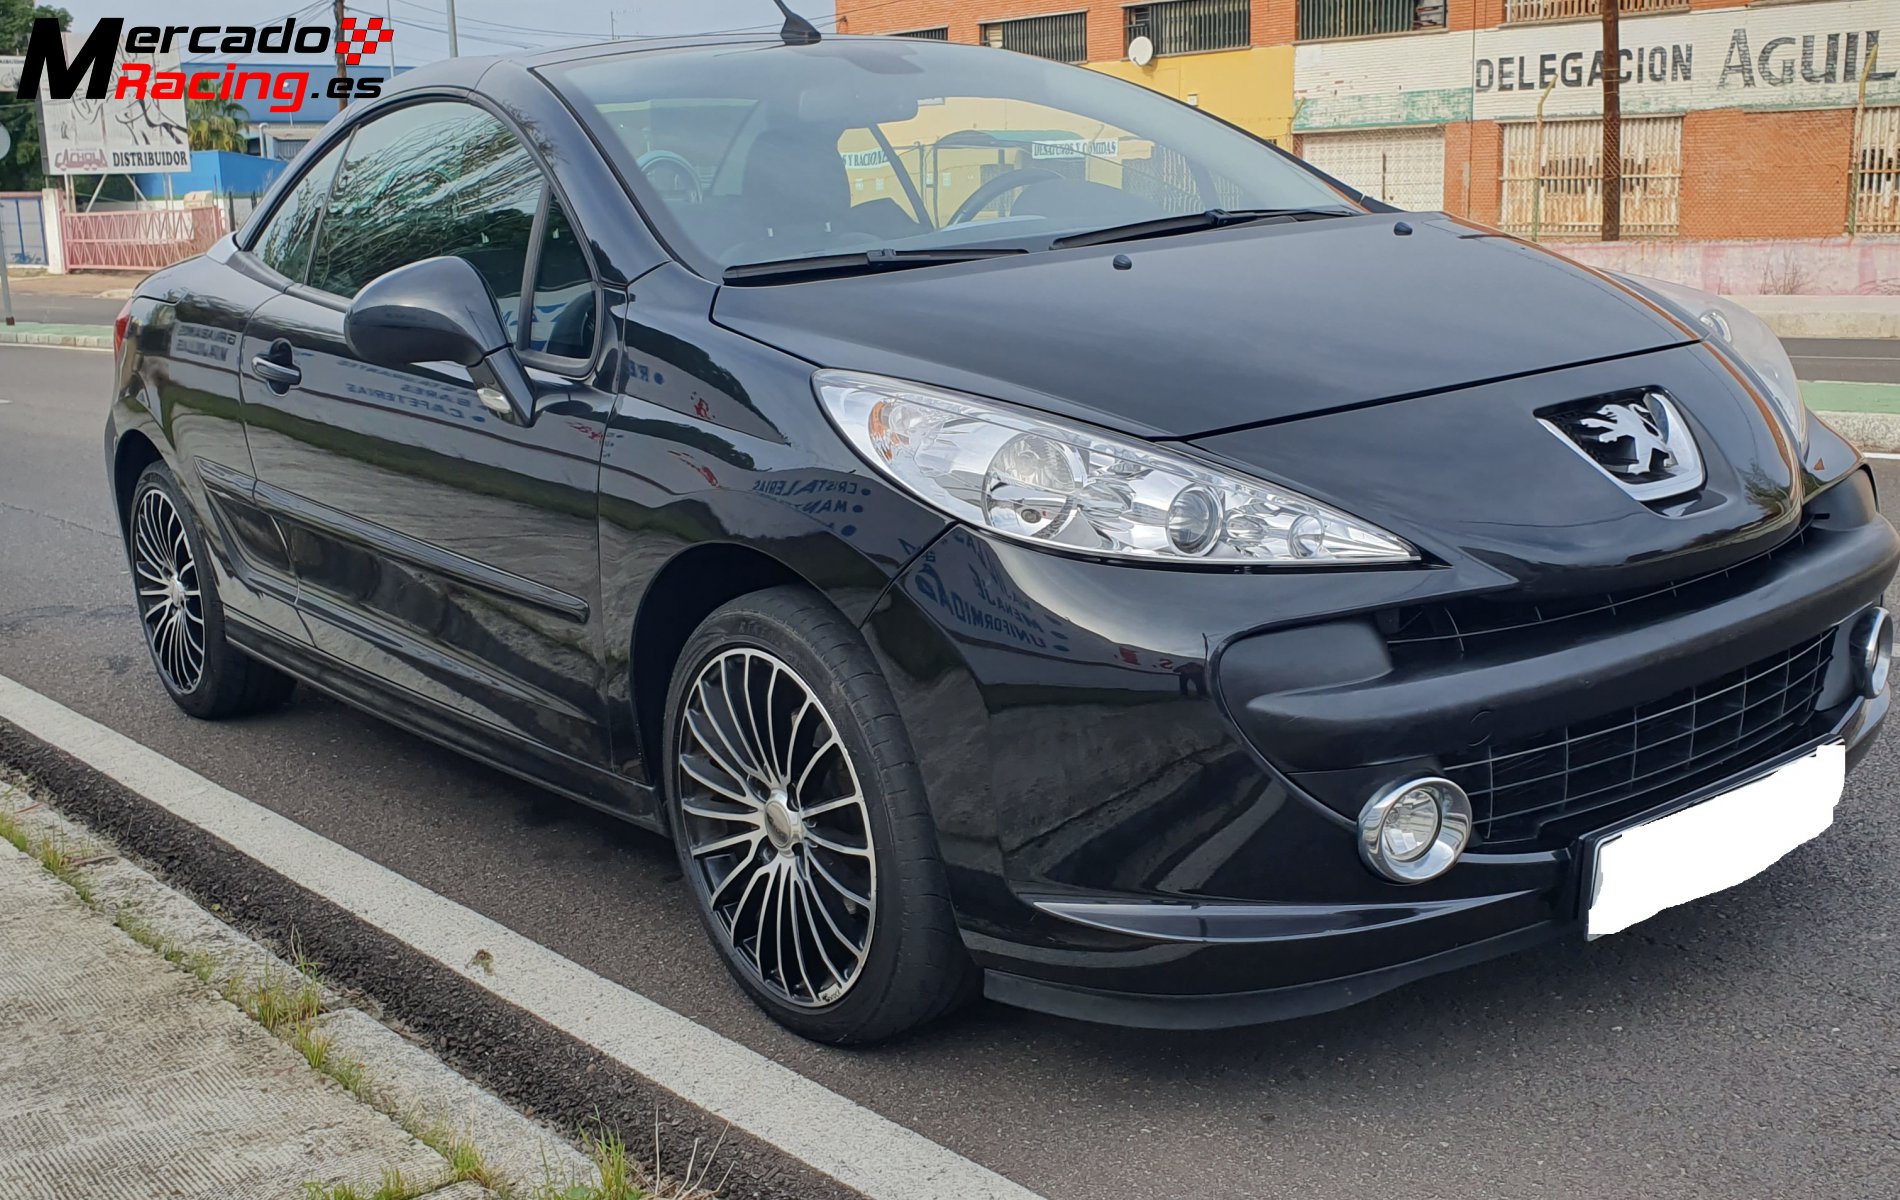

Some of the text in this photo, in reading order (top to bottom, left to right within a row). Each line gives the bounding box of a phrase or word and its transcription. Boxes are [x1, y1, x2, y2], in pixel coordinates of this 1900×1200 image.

[1475, 28, 1897, 93] DELEGACION AGUIL
[112, 150, 188, 167] DISTRIBUIDOR
